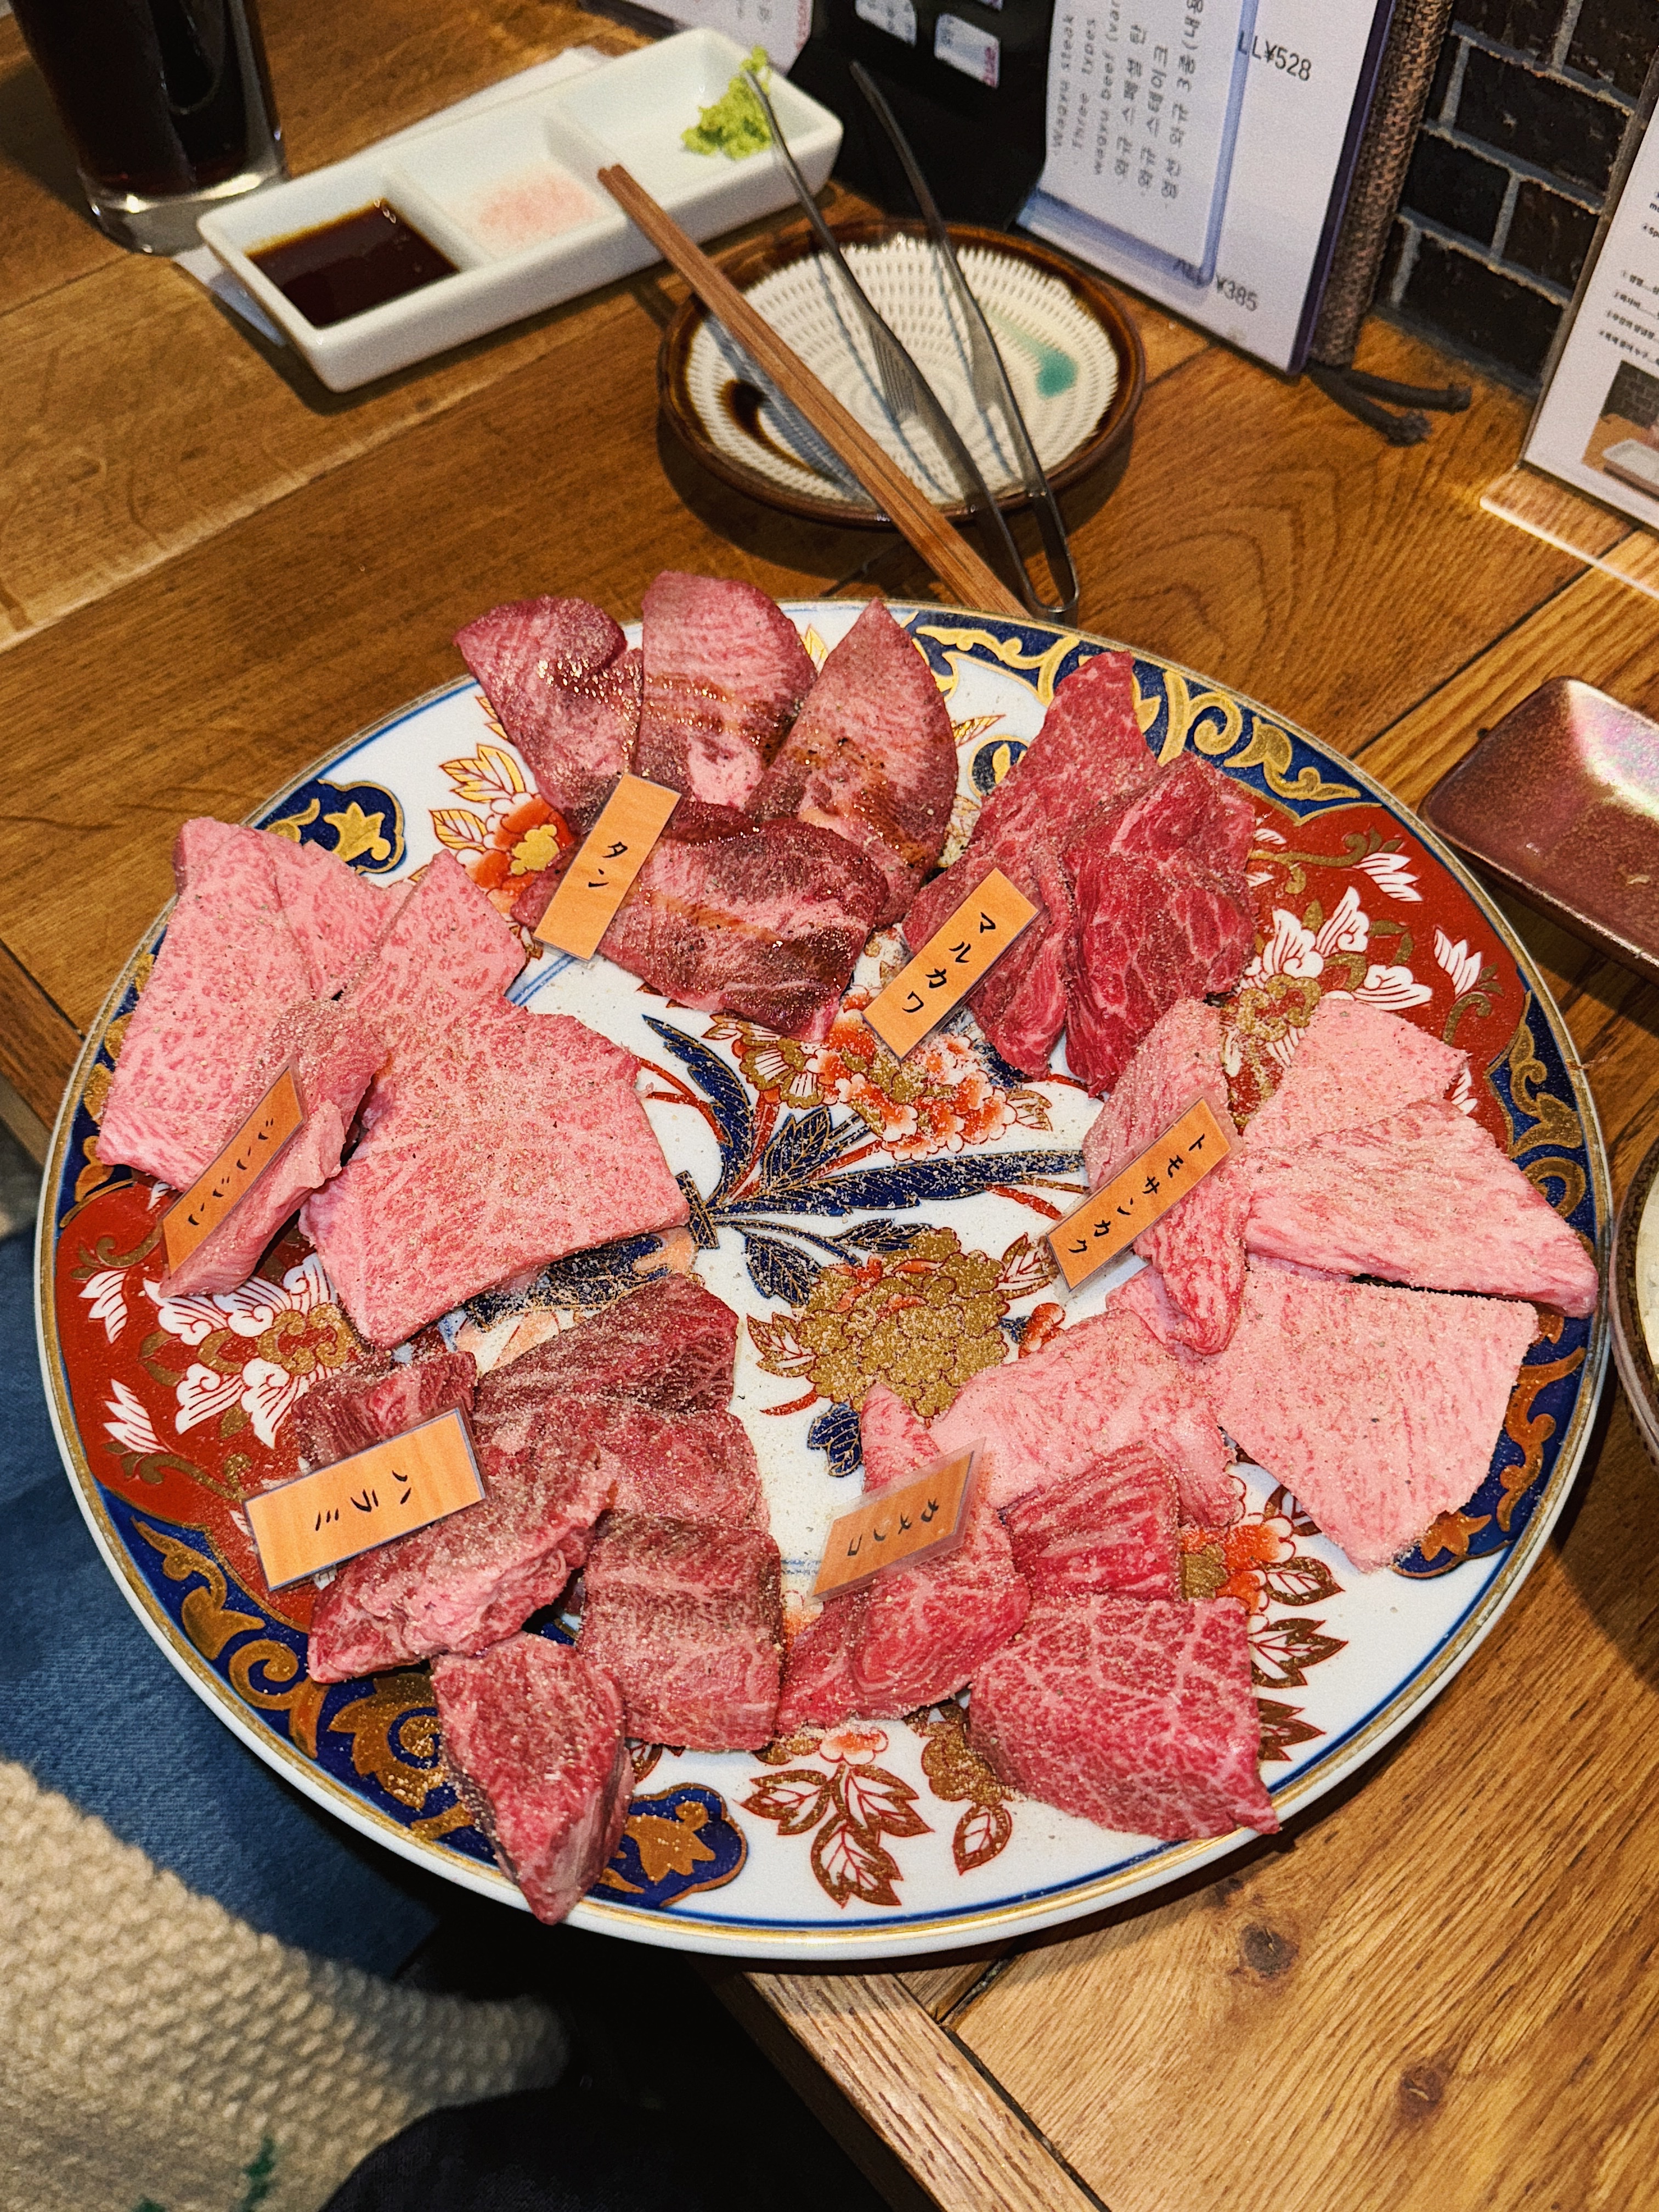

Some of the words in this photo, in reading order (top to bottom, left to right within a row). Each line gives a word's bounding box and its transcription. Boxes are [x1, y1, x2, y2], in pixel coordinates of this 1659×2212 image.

[1061, 15, 1074, 71] steak
[1101, 49, 1115, 101] beef
[1072, 92, 1089, 149] Three
[1081, 18, 1096, 75] types
[1146, 45, 1169, 138] 스테이크
[588, 841, 628, 888] タン
[902, 912, 996, 1013] マルカワ
[188, 1118, 274, 1226] シンシン
[1068, 1133, 1205, 1253] トモサンカク
[315, 1470, 412, 1531] ハラミ
[847, 1498, 939, 1556] カメノコ
